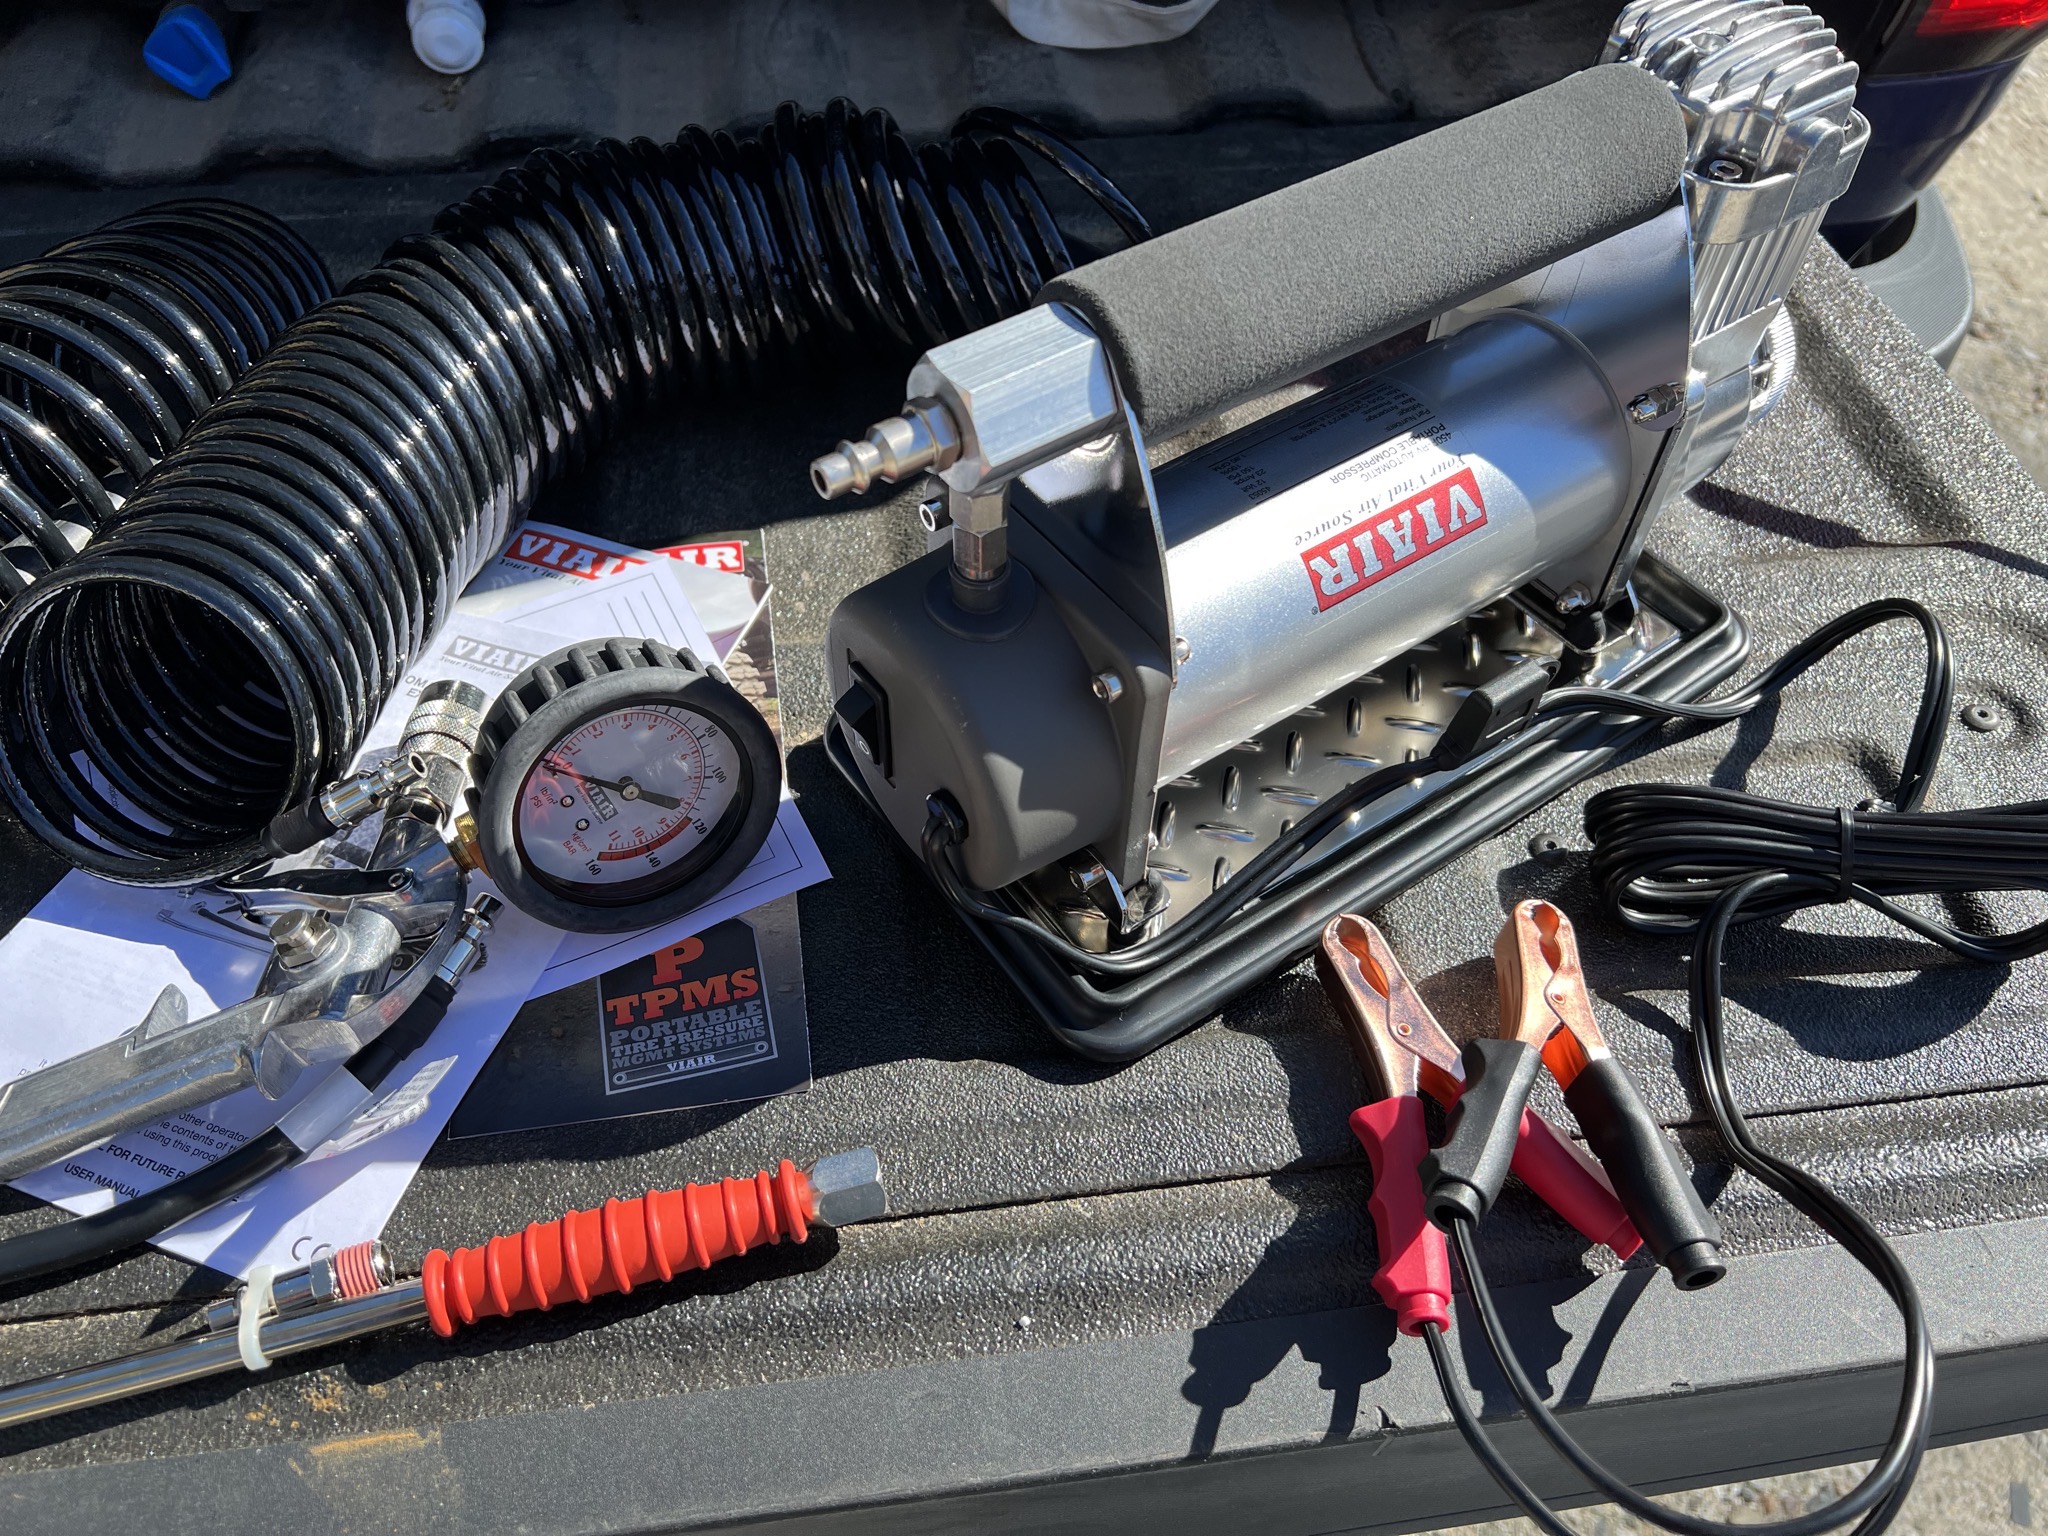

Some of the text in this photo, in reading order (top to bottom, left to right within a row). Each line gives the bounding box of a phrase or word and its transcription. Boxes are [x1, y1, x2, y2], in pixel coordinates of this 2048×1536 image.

[1329, 423, 1446, 484] PORTABLE COMPRESSOR
[1361, 451, 1415, 482] AUTOMATIC
[1294, 454, 1466, 547] Your Vital Air Source
[1309, 484, 1482, 596] VIAIR
[520, 534, 631, 576] VIAI
[498, 557, 530, 572] Your
[531, 566, 565, 582] Vital
[439, 655, 461, 666] Your
[461, 661, 486, 673] Vital
[486, 668, 503, 678] Air
[704, 724, 718, 738] 80
[712, 766, 726, 783] 100
[531, 796, 543, 808] PSI
[585, 782, 615, 819] VIAIR
[608, 830, 621, 841] 11
[632, 825, 644, 838] 10
[692, 818, 707, 835] 120
[563, 841, 577, 855] BAR
[645, 851, 661, 868] 140
[585, 859, 601, 876] 160
[652, 936, 704, 985] P
[606, 967, 759, 1026] TPMS
[609, 1000, 761, 1047] PORTABLE
[610, 1015, 764, 1058] TIRE PRESSURE
[612, 1026, 766, 1069] MGMT SYSTEMS
[667, 1054, 716, 1072] VIAIR
[144, 1129, 172, 1147] using
[172, 1138, 190, 1152] this
[171, 1125, 214, 1146] contents
[216, 1140, 230, 1152] of
[106, 1145, 131, 1161] FOR
[131, 1154, 177, 1177] FUTURE
[64, 1162, 141, 1198] USER MANUAL
